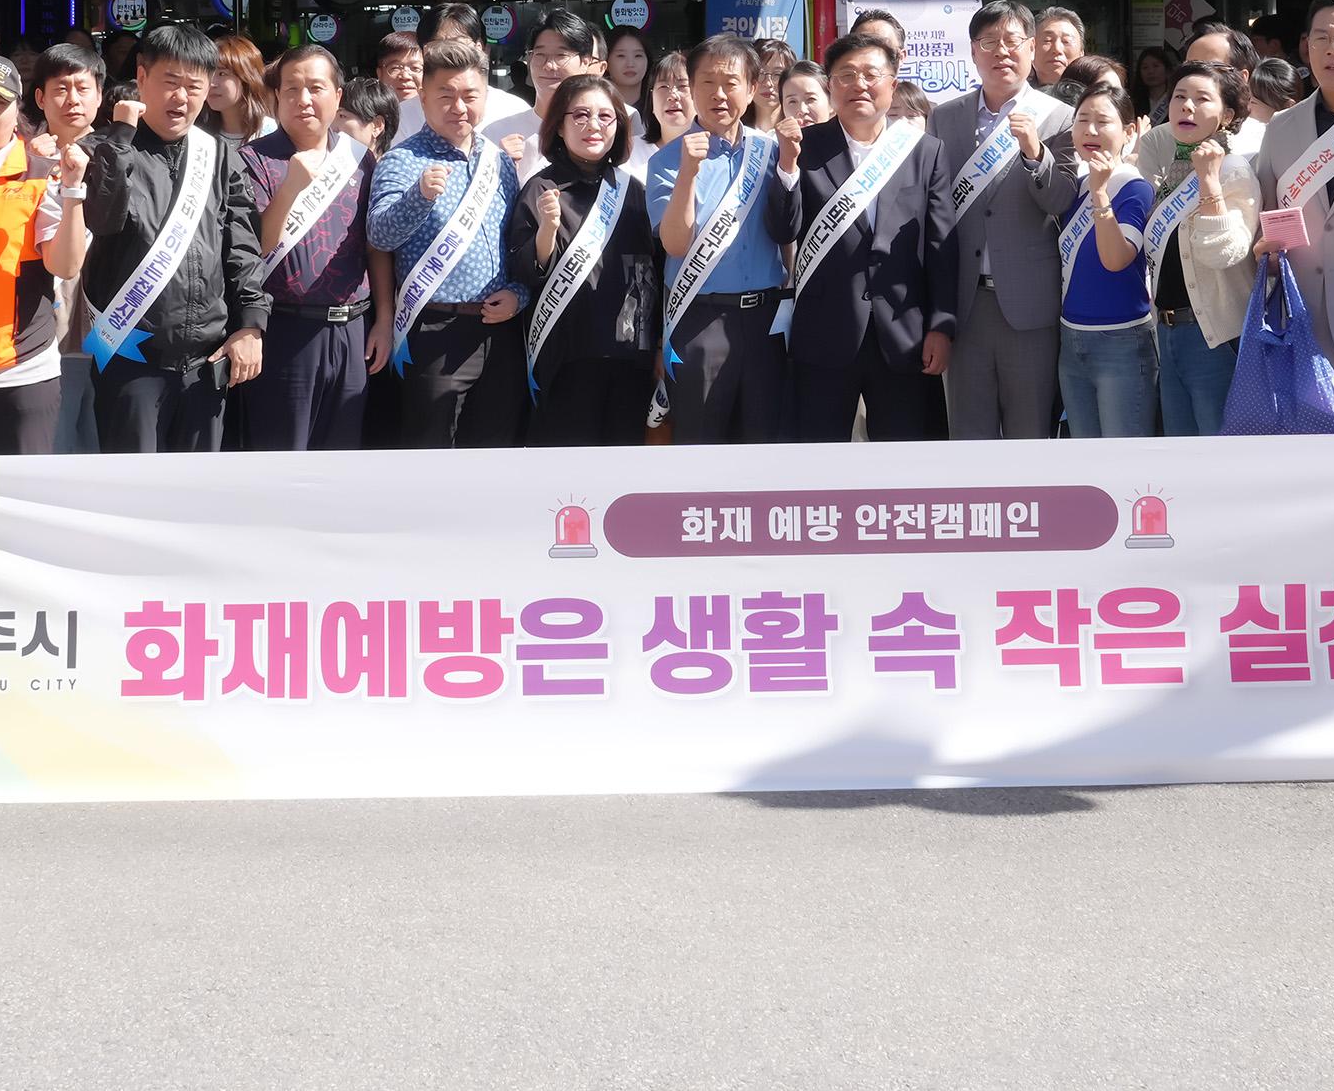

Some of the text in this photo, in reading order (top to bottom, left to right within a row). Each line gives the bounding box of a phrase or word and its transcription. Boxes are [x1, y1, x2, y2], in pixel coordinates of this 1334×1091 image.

[679, 502, 1041, 545] 화재 예방 안전캠페인
[119, 594, 609, 704] 화재예방은
[640, 590, 838, 695] 생활
[868, 590, 963, 691] 속
[995, 585, 1186, 690] 작은
[30, 678, 77, 691] CITY
